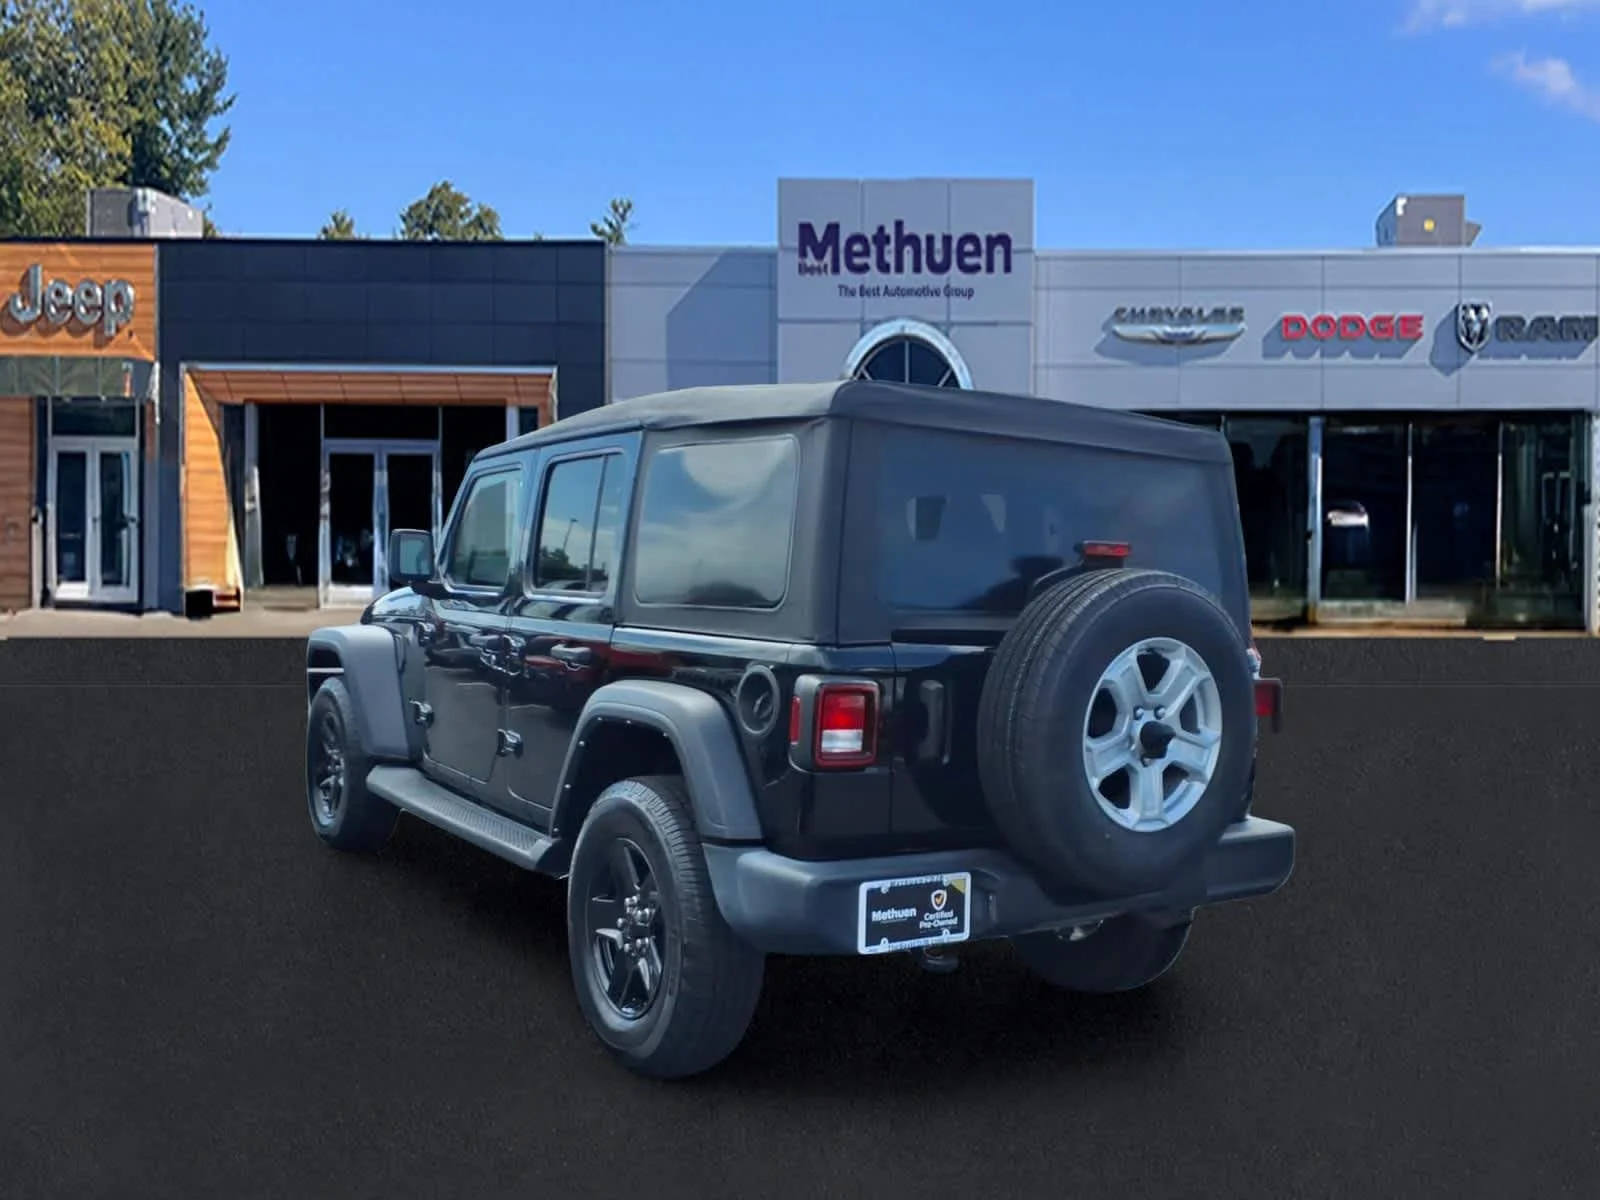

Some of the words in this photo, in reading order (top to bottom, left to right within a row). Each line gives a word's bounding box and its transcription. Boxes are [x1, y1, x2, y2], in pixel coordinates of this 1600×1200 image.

[798, 219, 1012, 275] Methuen
[9, 263, 135, 336] Jeep
[838, 284, 857, 297] The
[859, 284, 881, 297] Best
[883, 284, 941, 297] Automotive
[943, 284, 975, 300] Group
[1114, 306, 1244, 323] CHRYSLER
[1281, 313, 1424, 339] DODGE
[1495, 315, 1598, 341] RAM
[871, 907, 917, 921] Methuen
[919, 916, 958, 929] Pre-Owned
[923, 910, 954, 921] Certified
